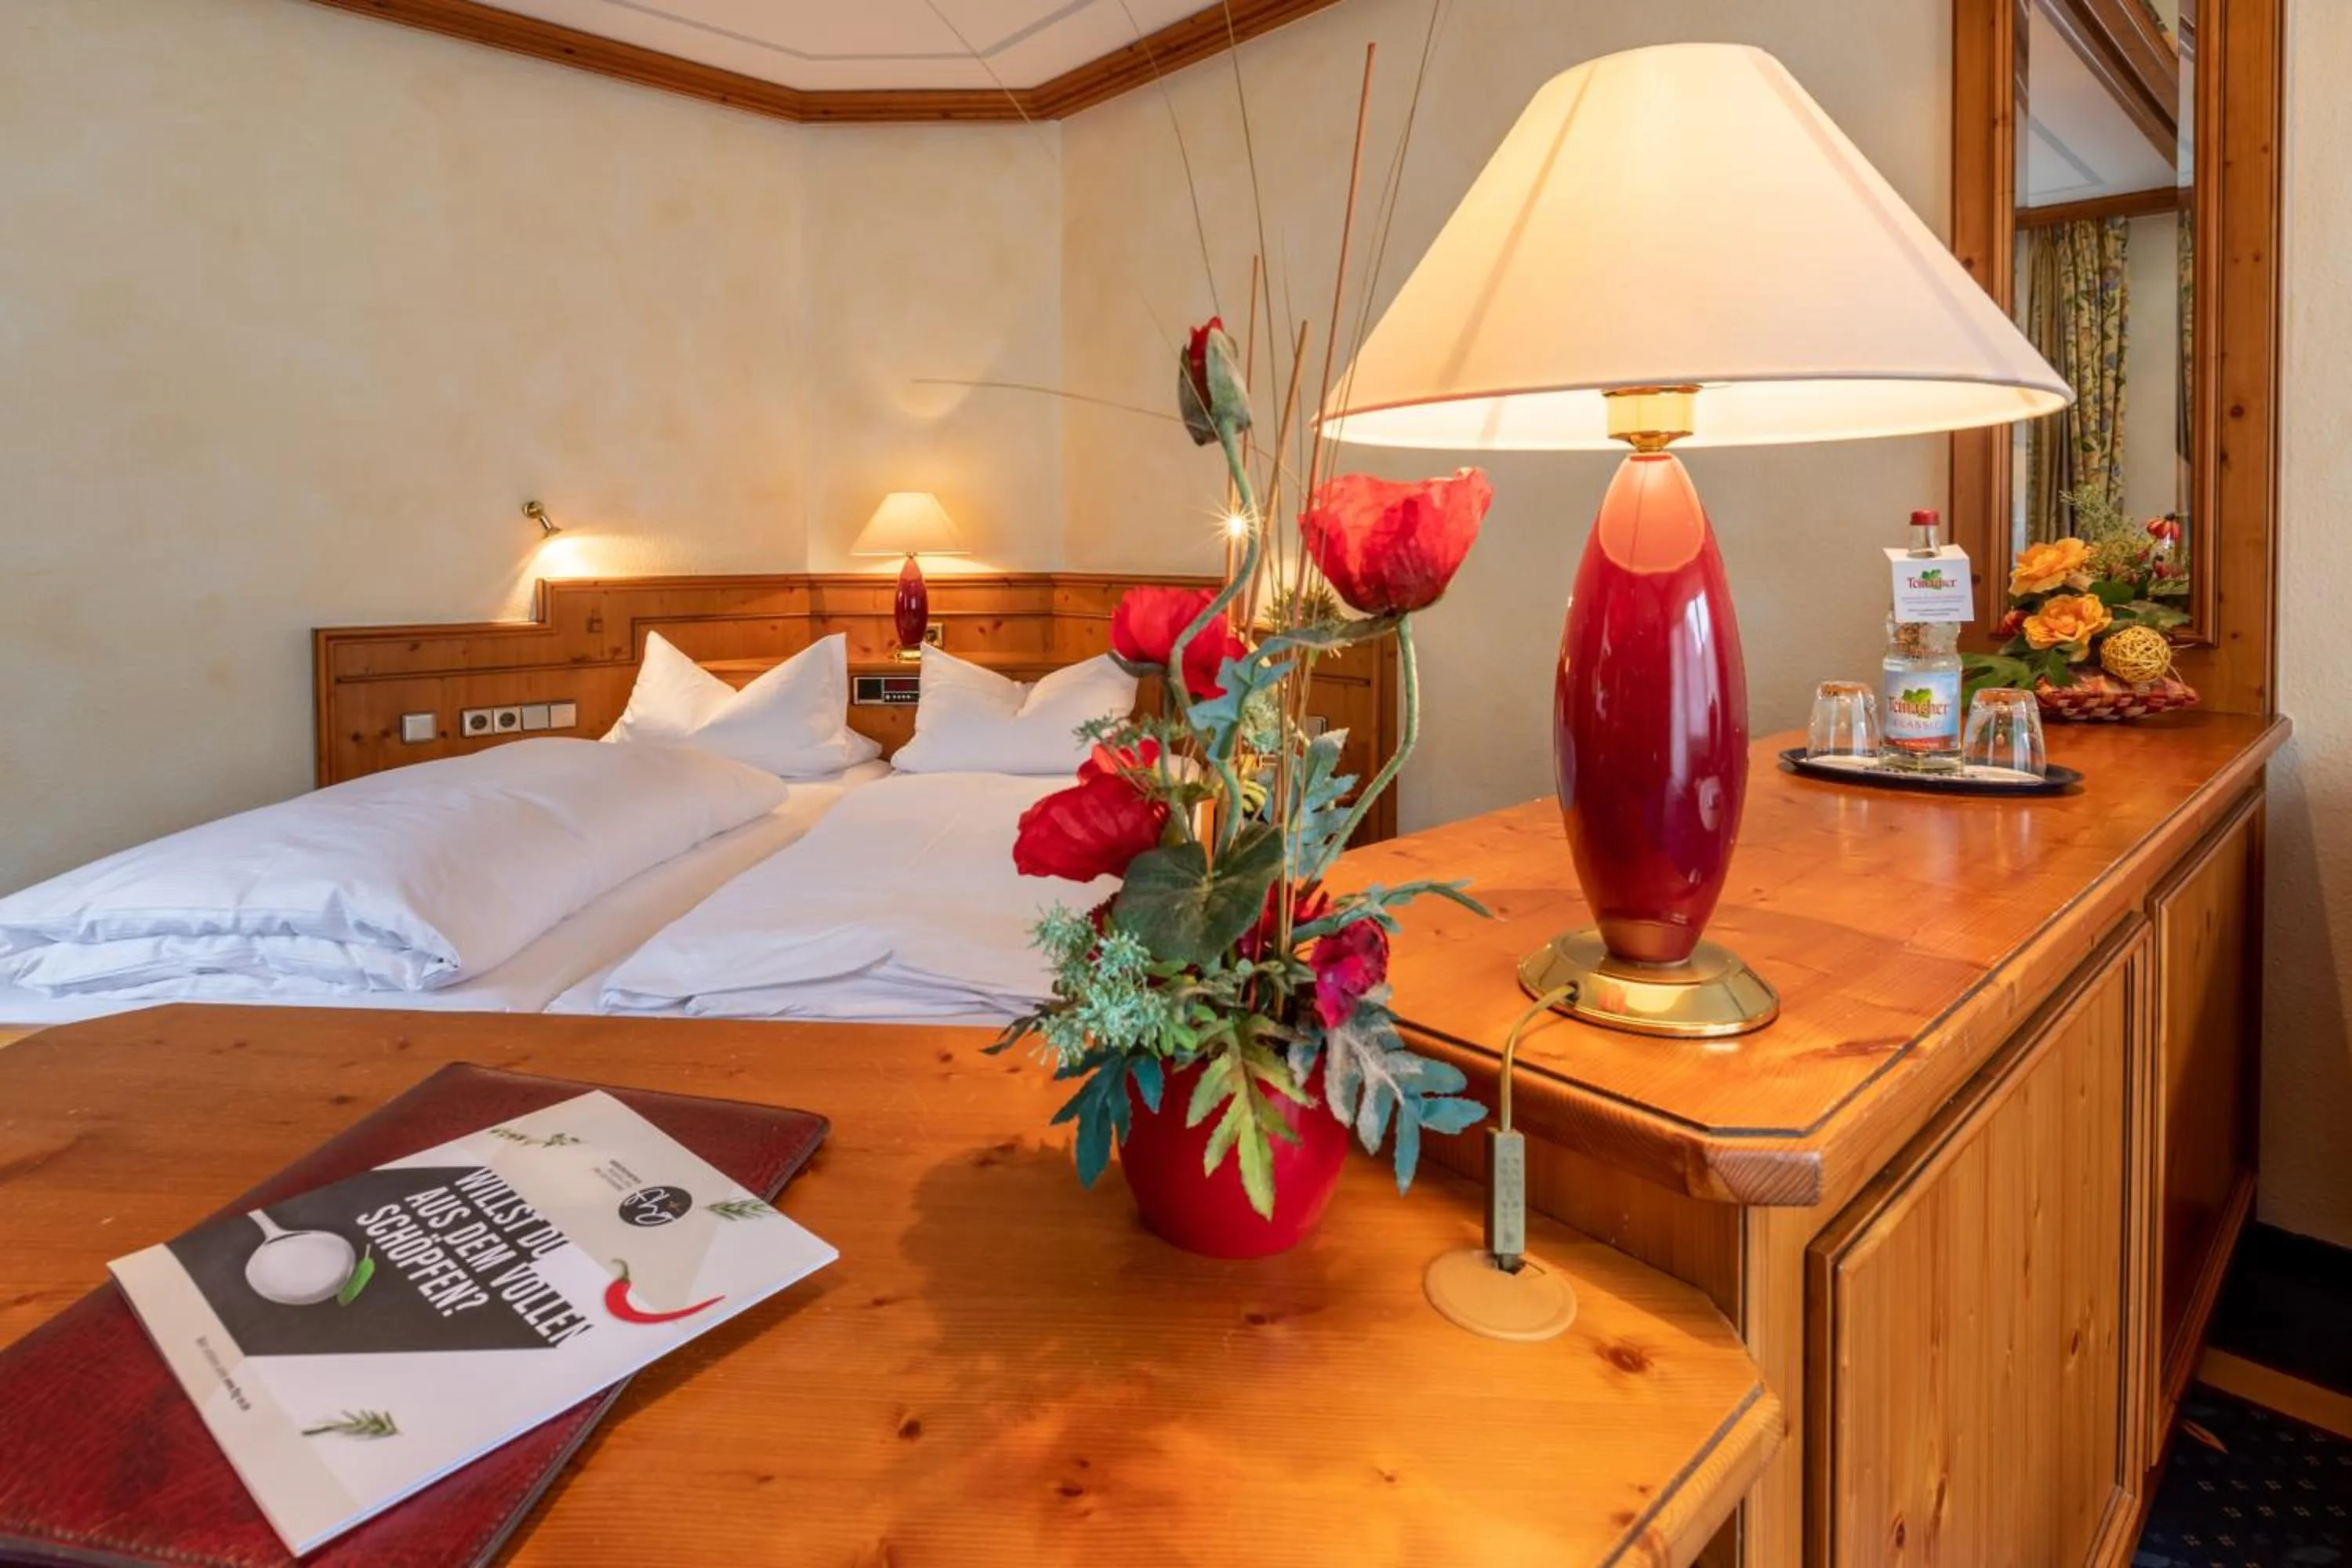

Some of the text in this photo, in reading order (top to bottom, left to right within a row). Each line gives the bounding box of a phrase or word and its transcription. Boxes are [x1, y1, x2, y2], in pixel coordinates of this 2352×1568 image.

[355, 1203, 490, 1318] SCHÖPFEN?
[403, 1185, 595, 1344] AUS DEM VOLLEN
[454, 1166, 544, 1233] WILLST
[516, 1225, 572, 1261] DU
